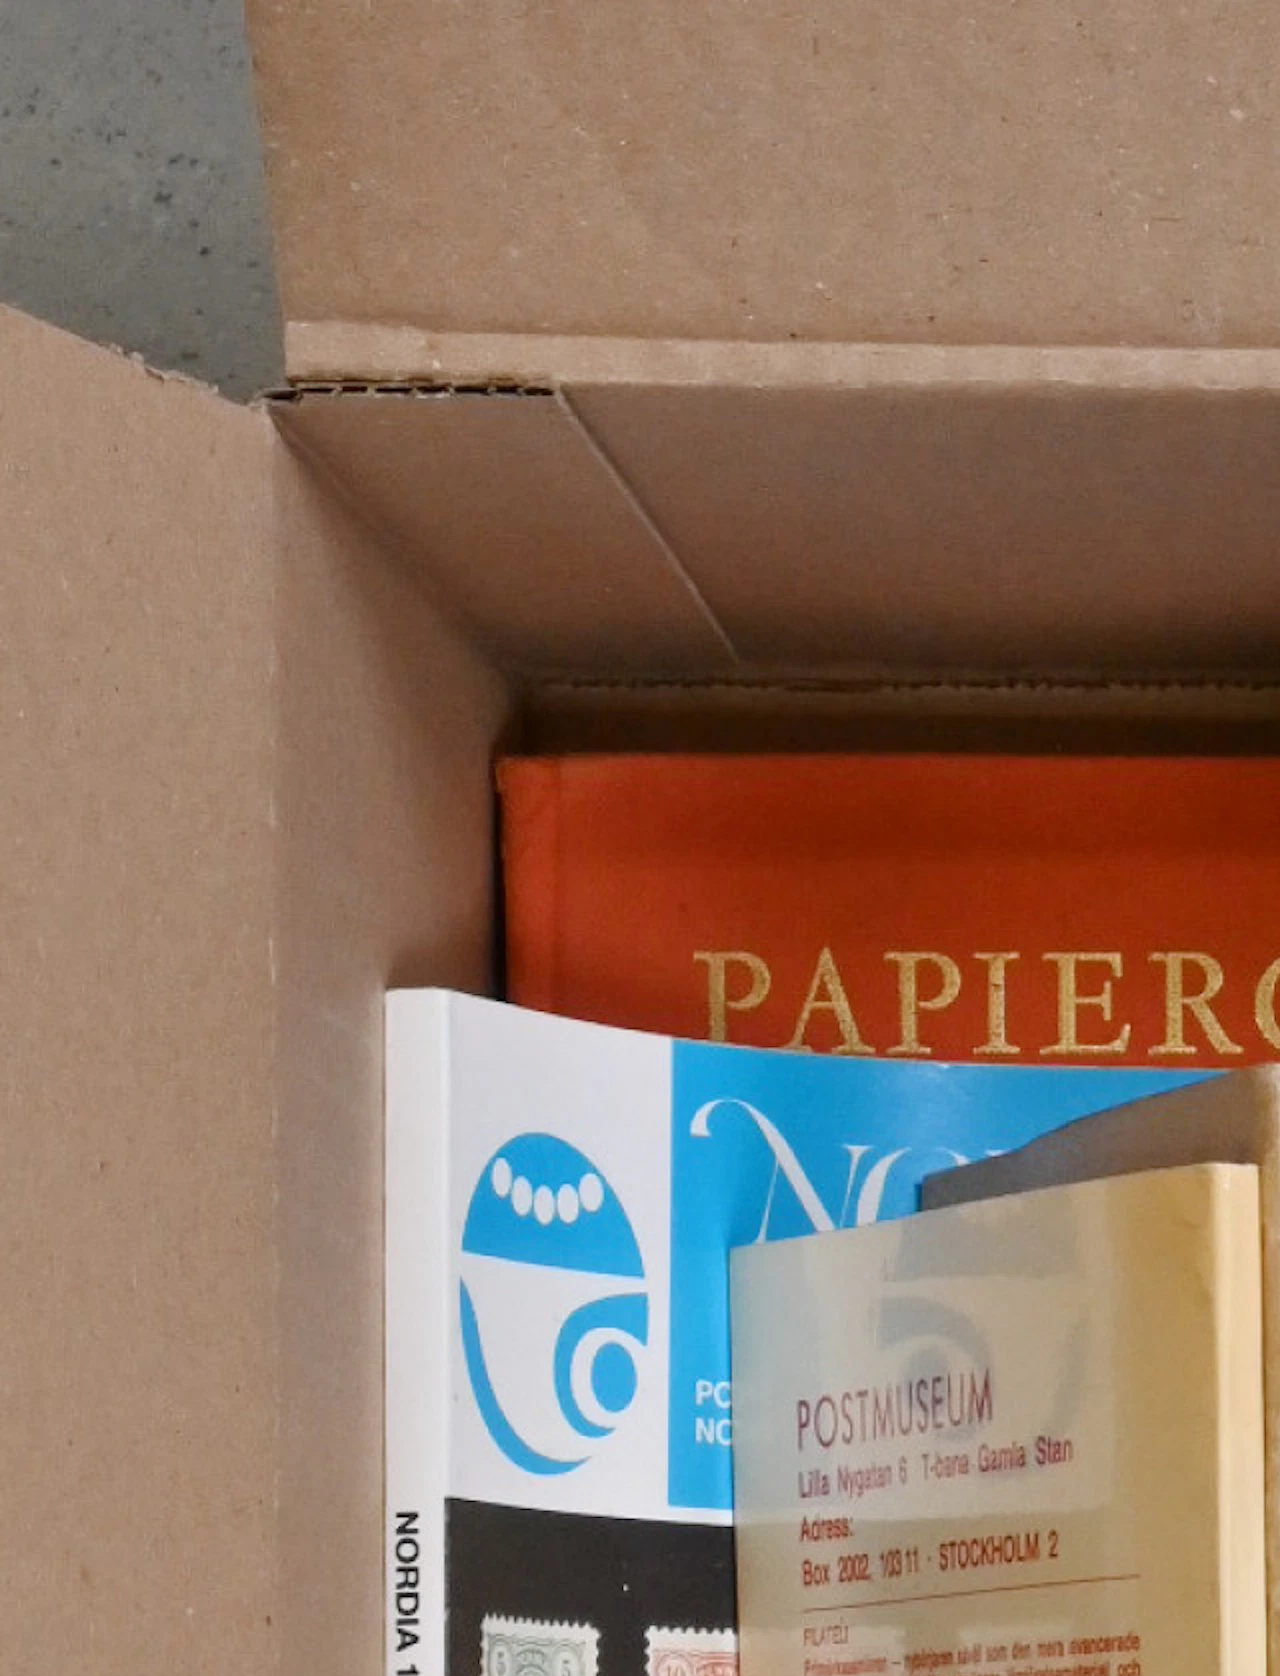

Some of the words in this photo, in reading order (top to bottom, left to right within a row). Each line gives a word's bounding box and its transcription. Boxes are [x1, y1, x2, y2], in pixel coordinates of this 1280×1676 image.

[797, 1367, 994, 1451] POSTMUSEUM
[799, 1464, 831, 1500] Lilla
[898, 1457, 908, 1486] 6
[977, 1442, 1027, 1473] Gamla
[1034, 1435, 1074, 1465] Stan
[800, 1515, 854, 1544] Adress:
[802, 1559, 831, 1587] Box
[938, 1531, 1040, 1573] STOCKHOLM
[1047, 1529, 1060, 1560] 2
[394, 1510, 420, 1654] NORDIA
